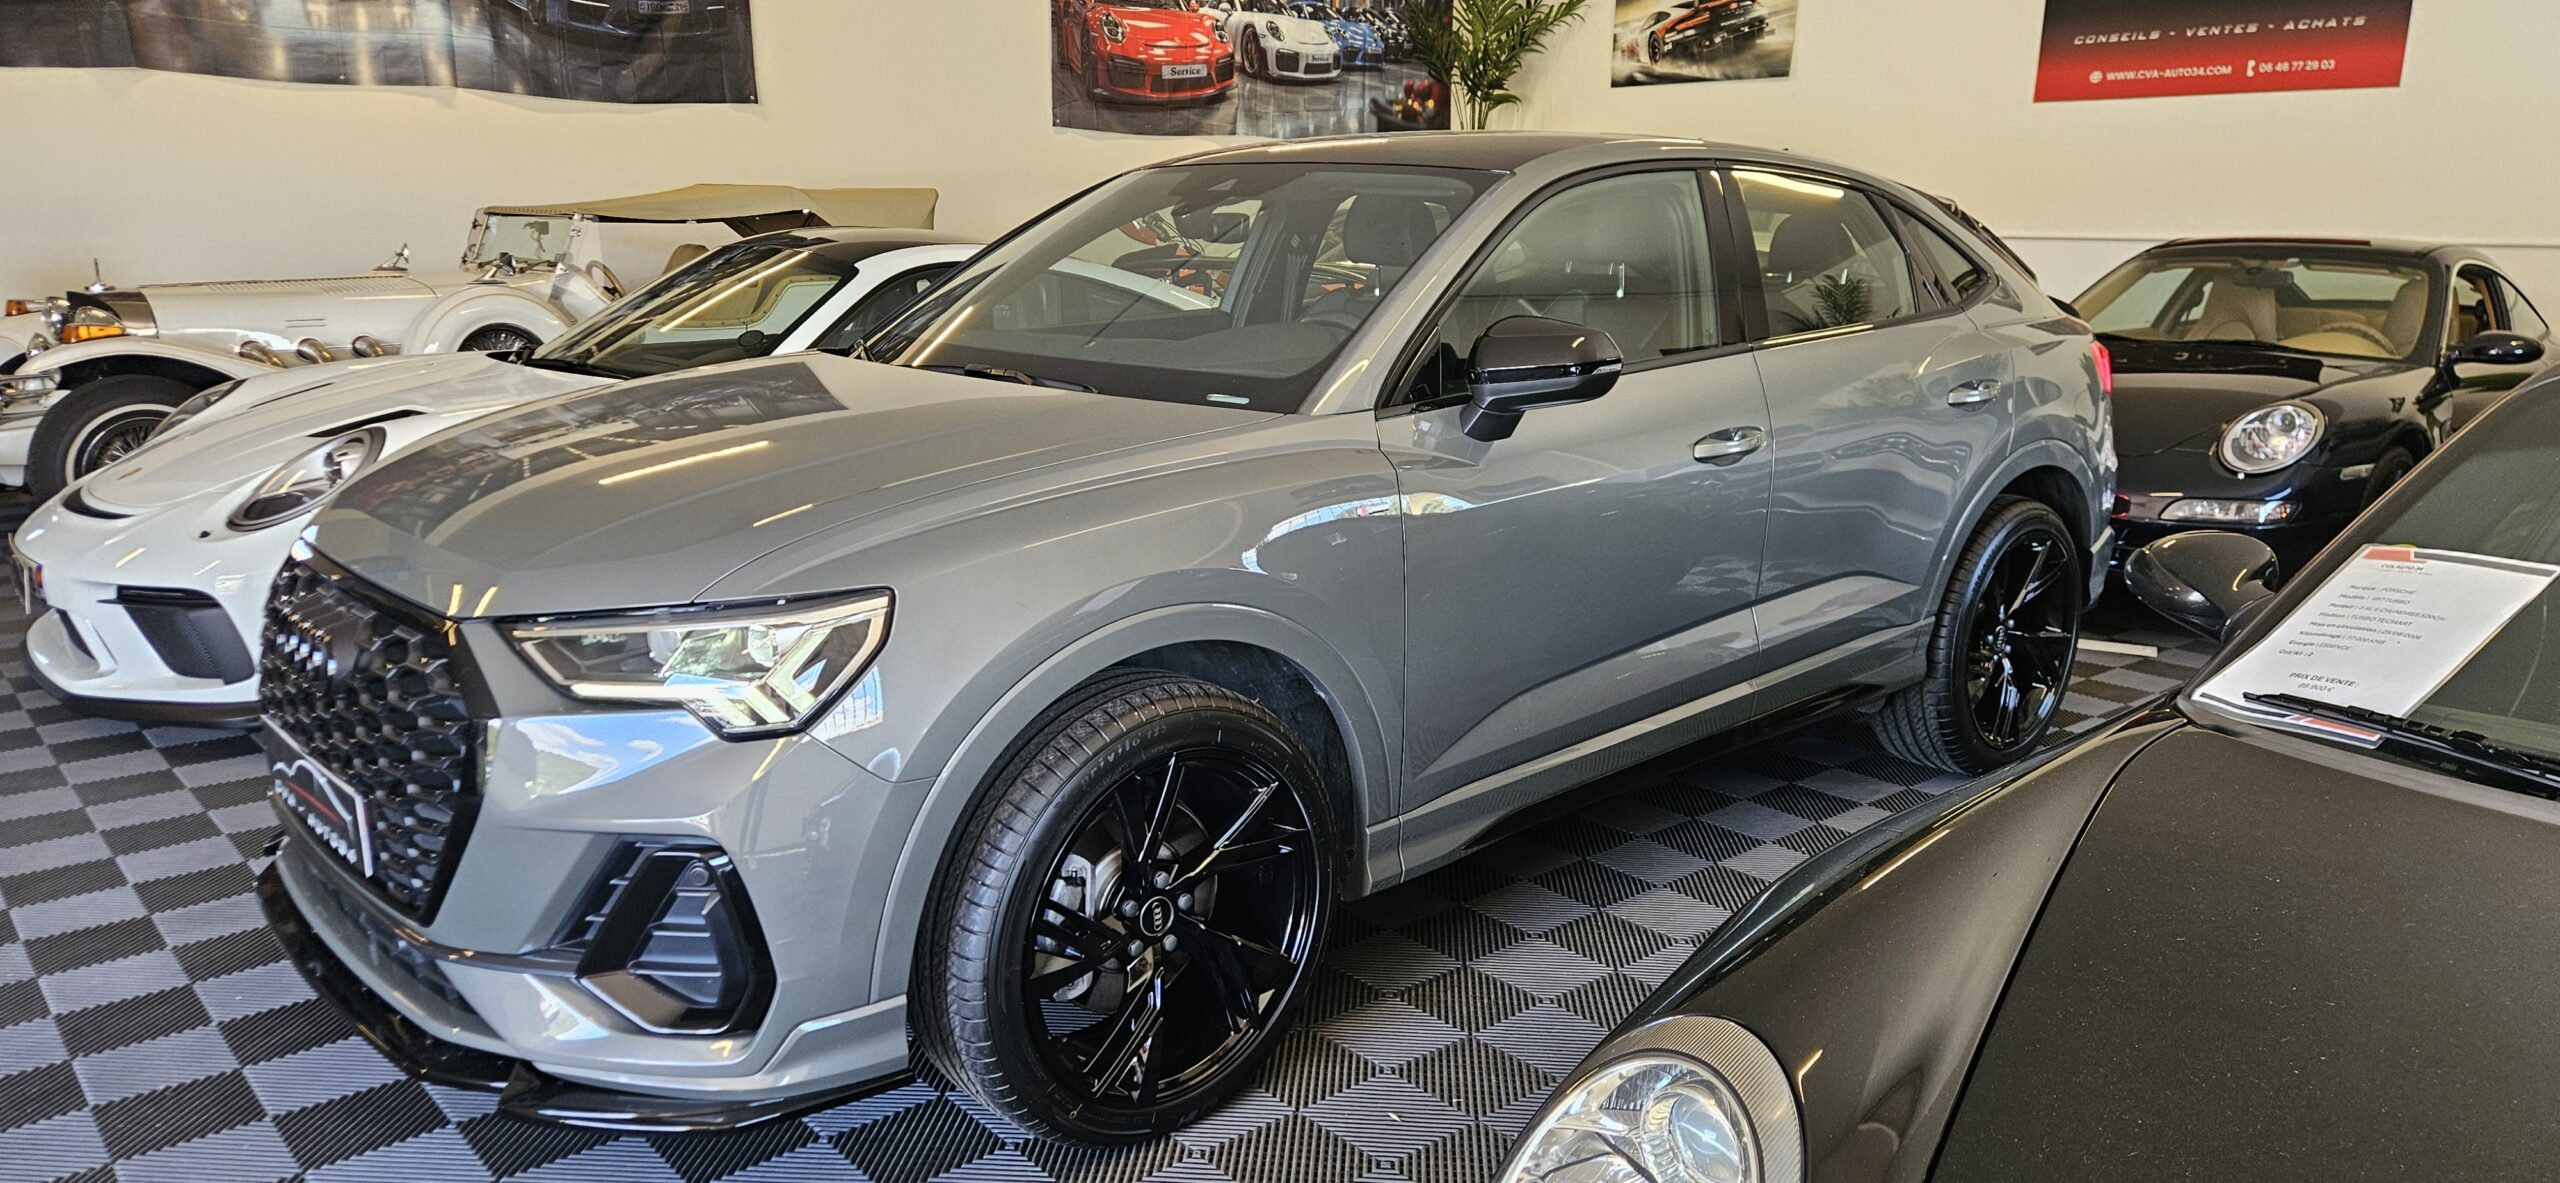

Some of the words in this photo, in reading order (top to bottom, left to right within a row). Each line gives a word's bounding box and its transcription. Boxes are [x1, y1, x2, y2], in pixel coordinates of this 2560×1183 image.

[2073, 30, 2160, 45] CONSEILS
[2186, 23, 2259, 38] VENTES
[2283, 15, 2367, 31] ACHATS
[1170, 66, 1201, 76] Service
[2291, 60, 2305, 71] 77
[2106, 64, 2233, 81] WWW.CVA-AUTO34.COM
[2288, 672, 2310, 680] PRIX
[2310, 674, 2324, 682] DE
